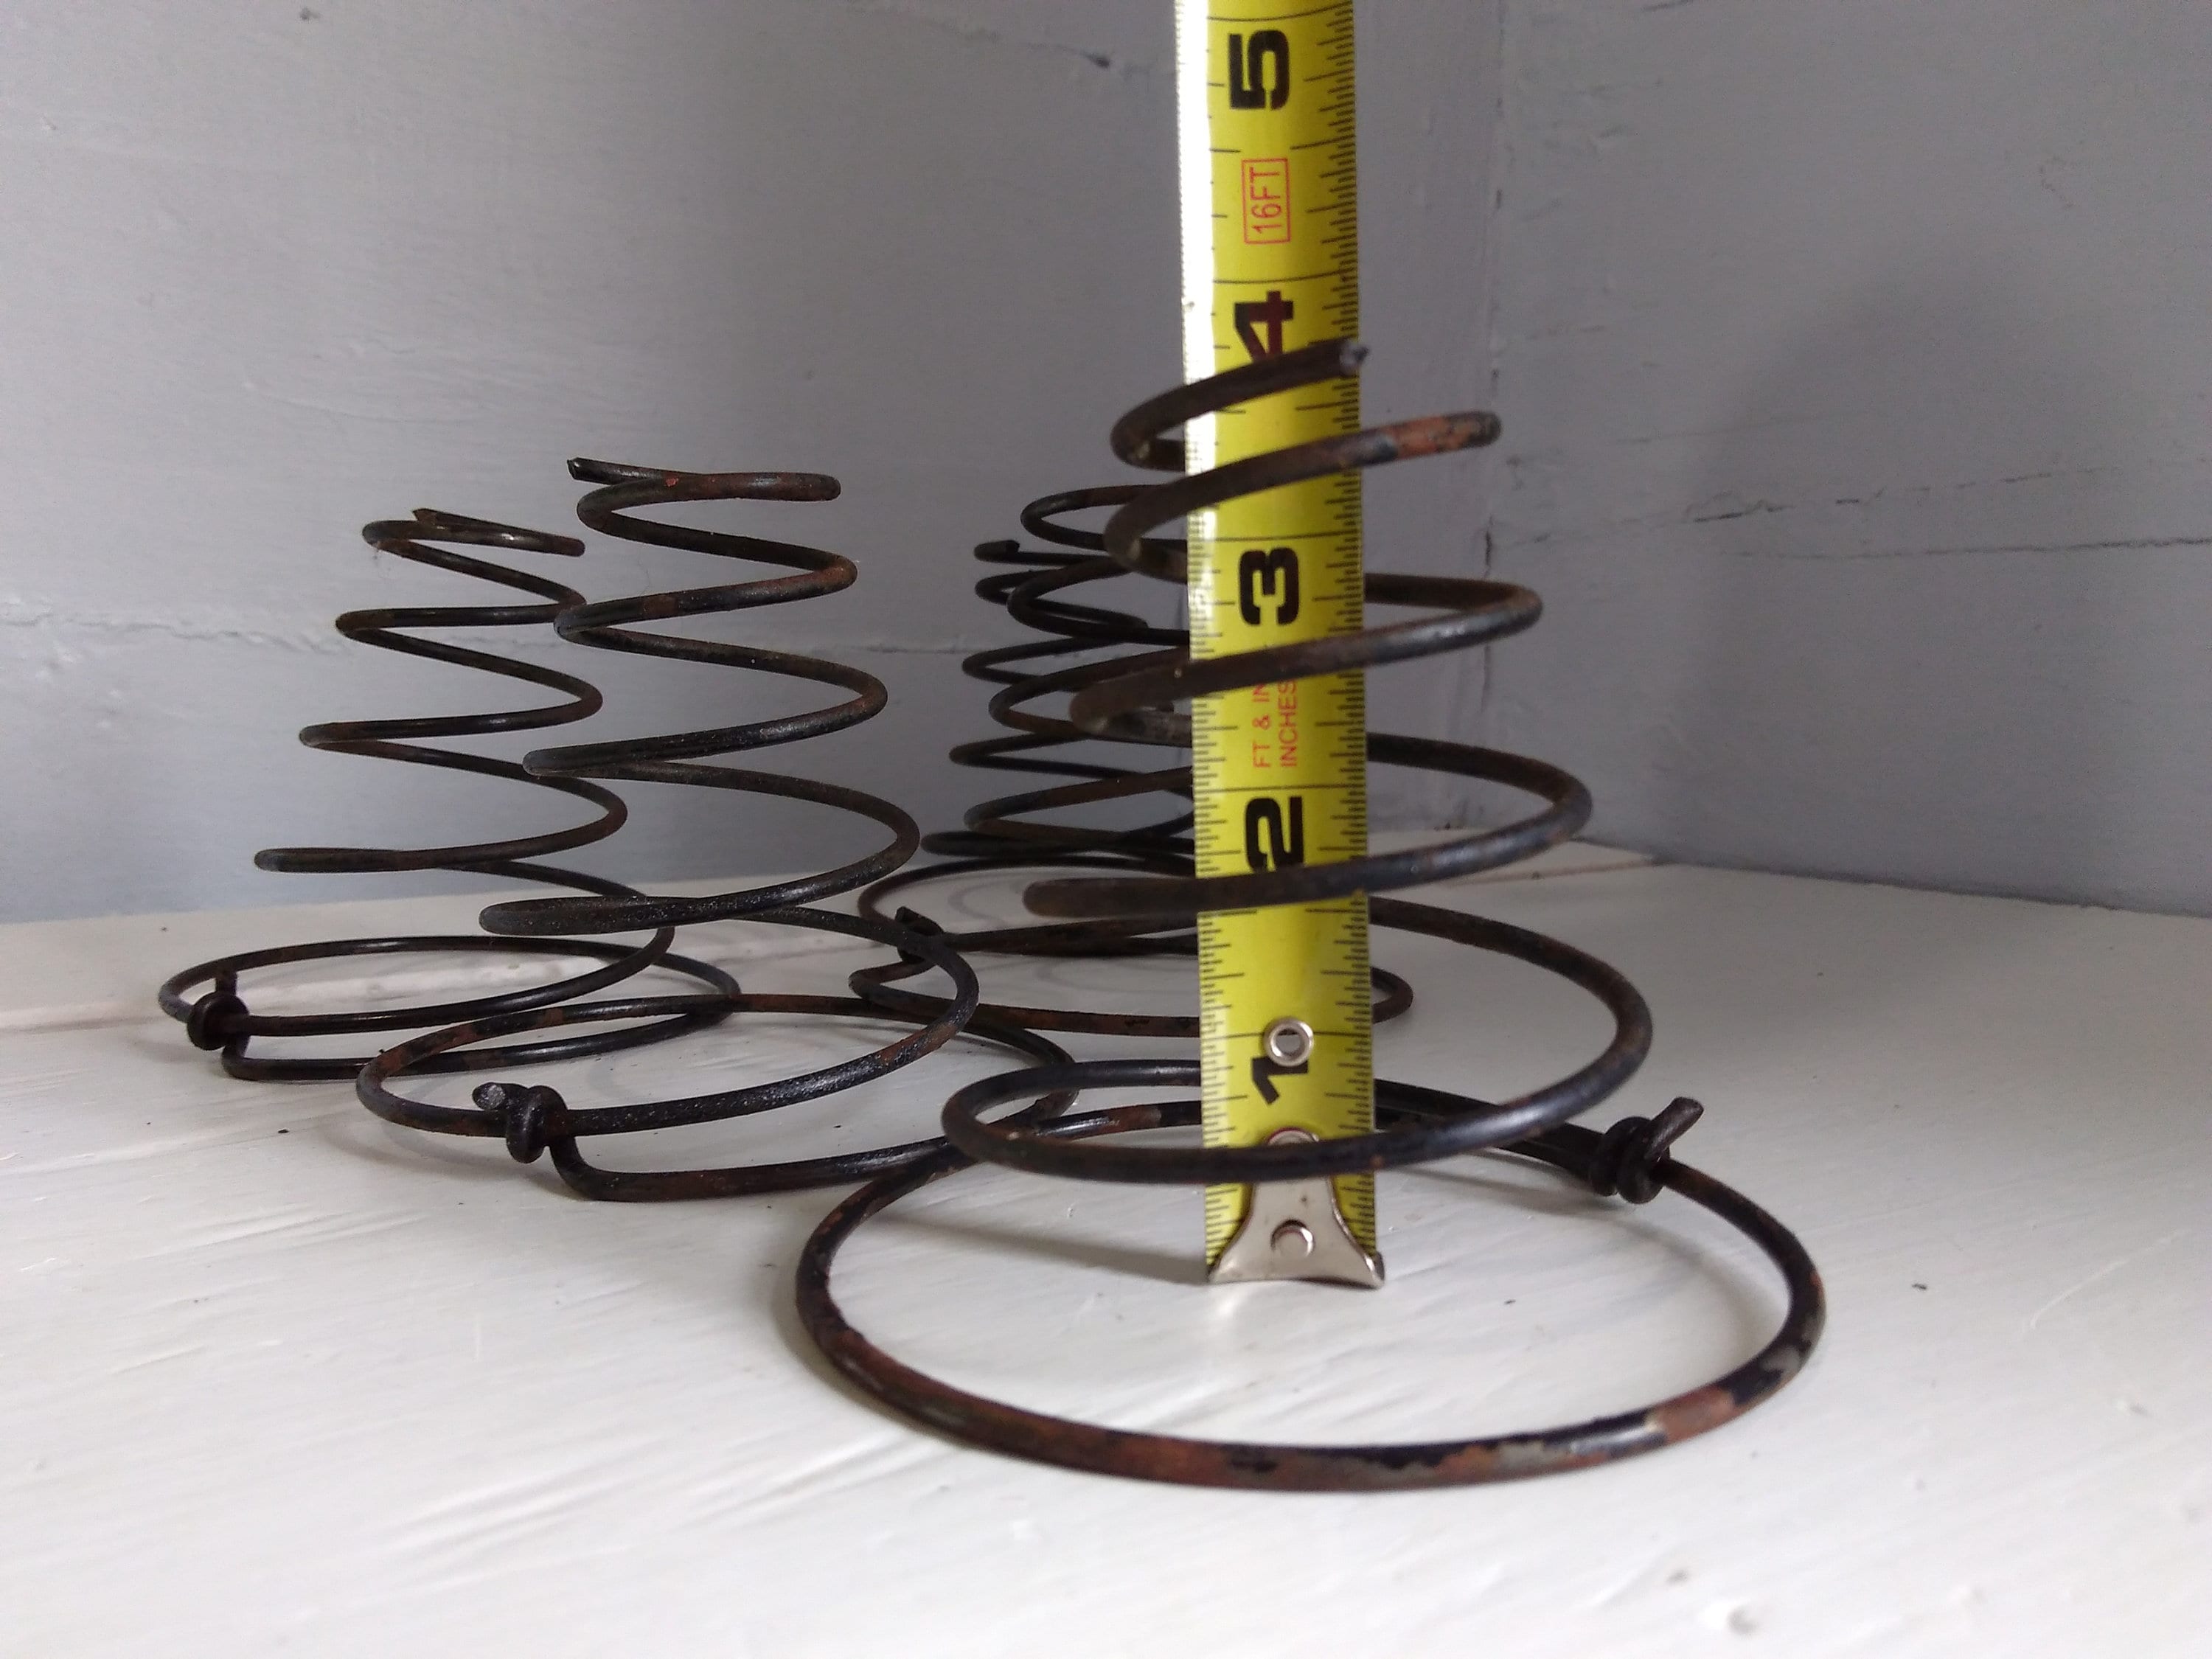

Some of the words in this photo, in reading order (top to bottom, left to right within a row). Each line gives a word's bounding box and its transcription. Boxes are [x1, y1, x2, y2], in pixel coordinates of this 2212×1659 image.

[1228, 29, 1290, 111] 5
[1248, 166, 1283, 234] 16FT
[1234, 291, 1294, 363] 4
[1239, 547, 1299, 625] 3
[1252, 714, 1271, 731] &
[1252, 741, 1271, 768] FT
[1278, 678, 1298, 768] INCHES
[1245, 796, 1304, 873] 2
[1251, 1055, 1309, 1105] 1
